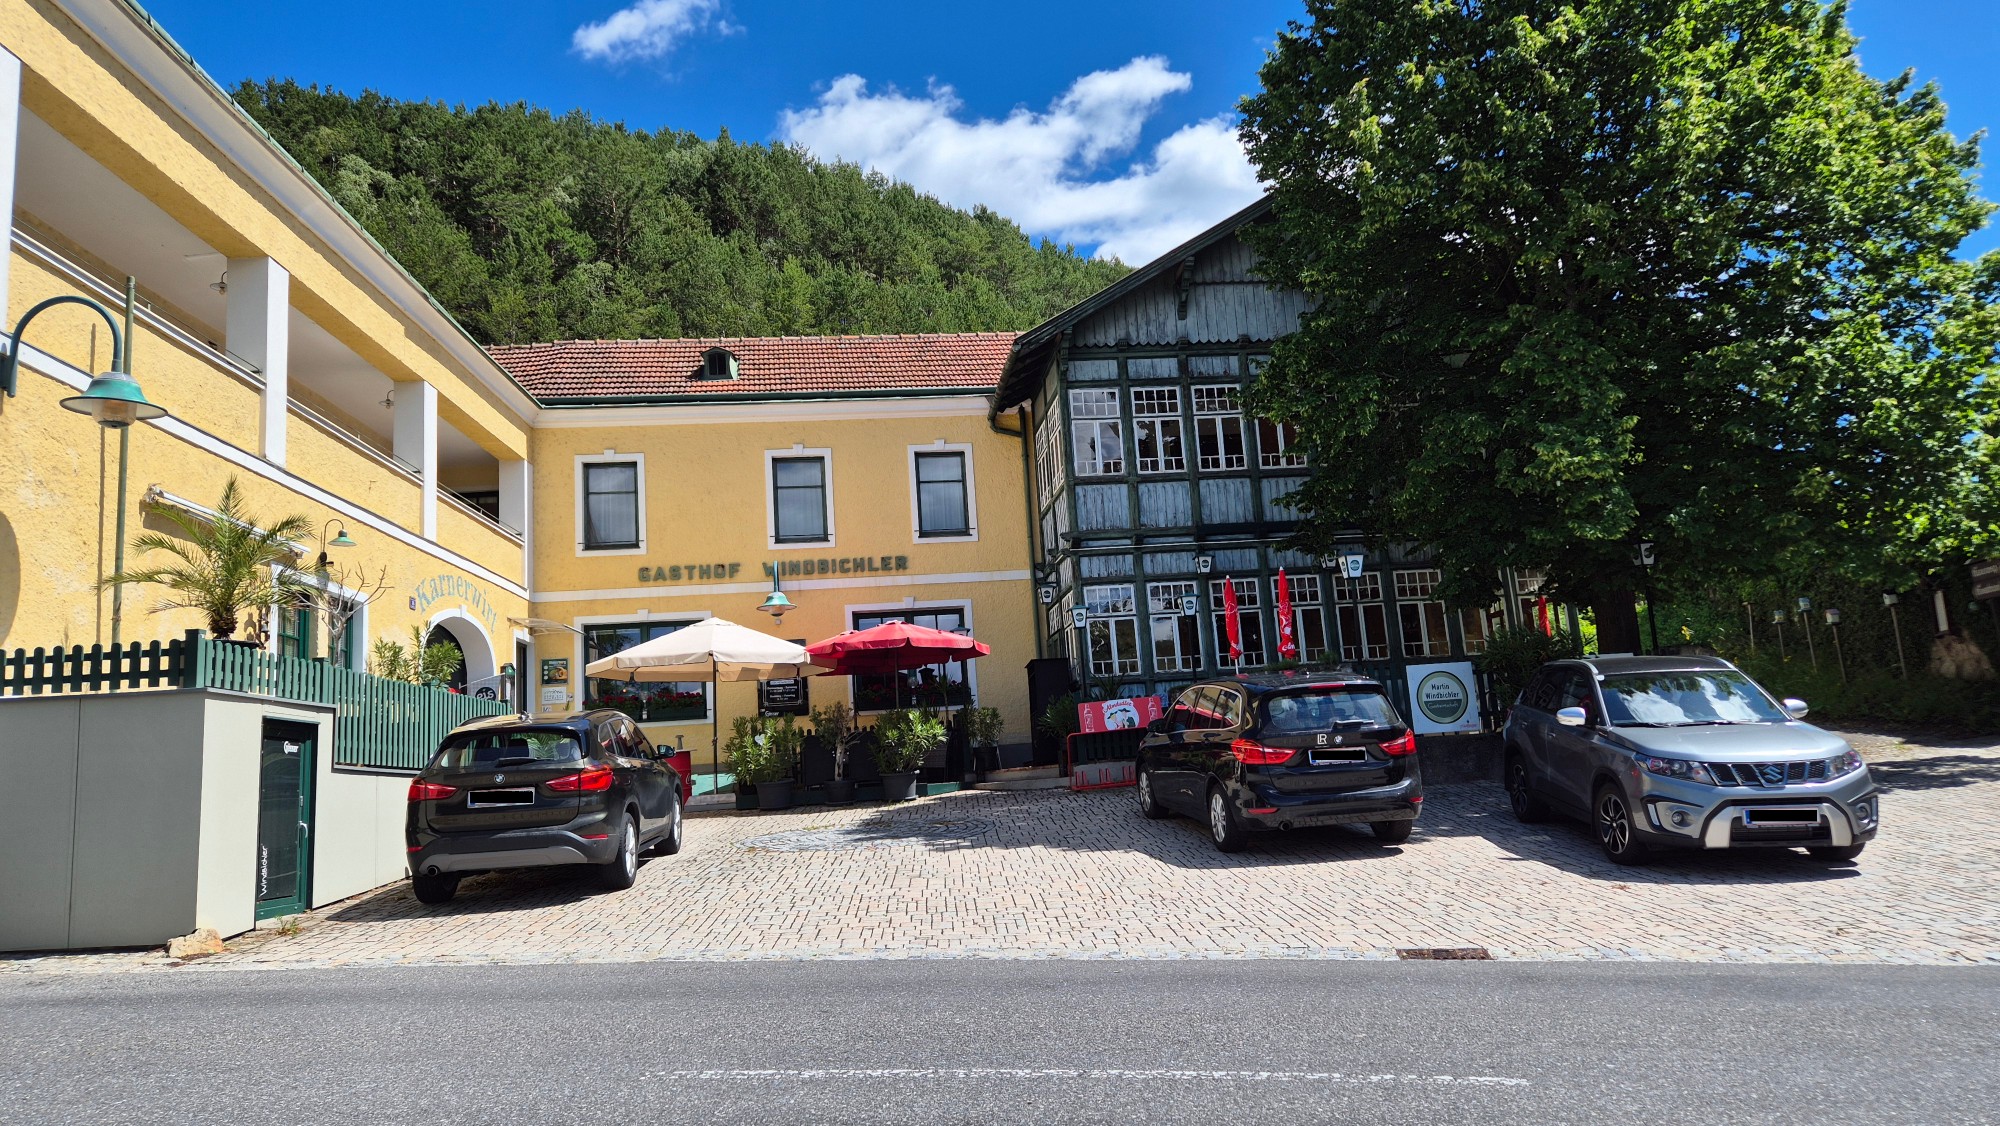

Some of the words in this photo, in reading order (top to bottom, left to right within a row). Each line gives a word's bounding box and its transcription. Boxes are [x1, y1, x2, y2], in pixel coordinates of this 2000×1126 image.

[638, 562, 741, 582] GASTHOF
[762, 555, 908, 578] WINDBICHLER
[415, 574, 497, 634] Karnerwirt
[1425, 691, 1459, 700] Windbichler
